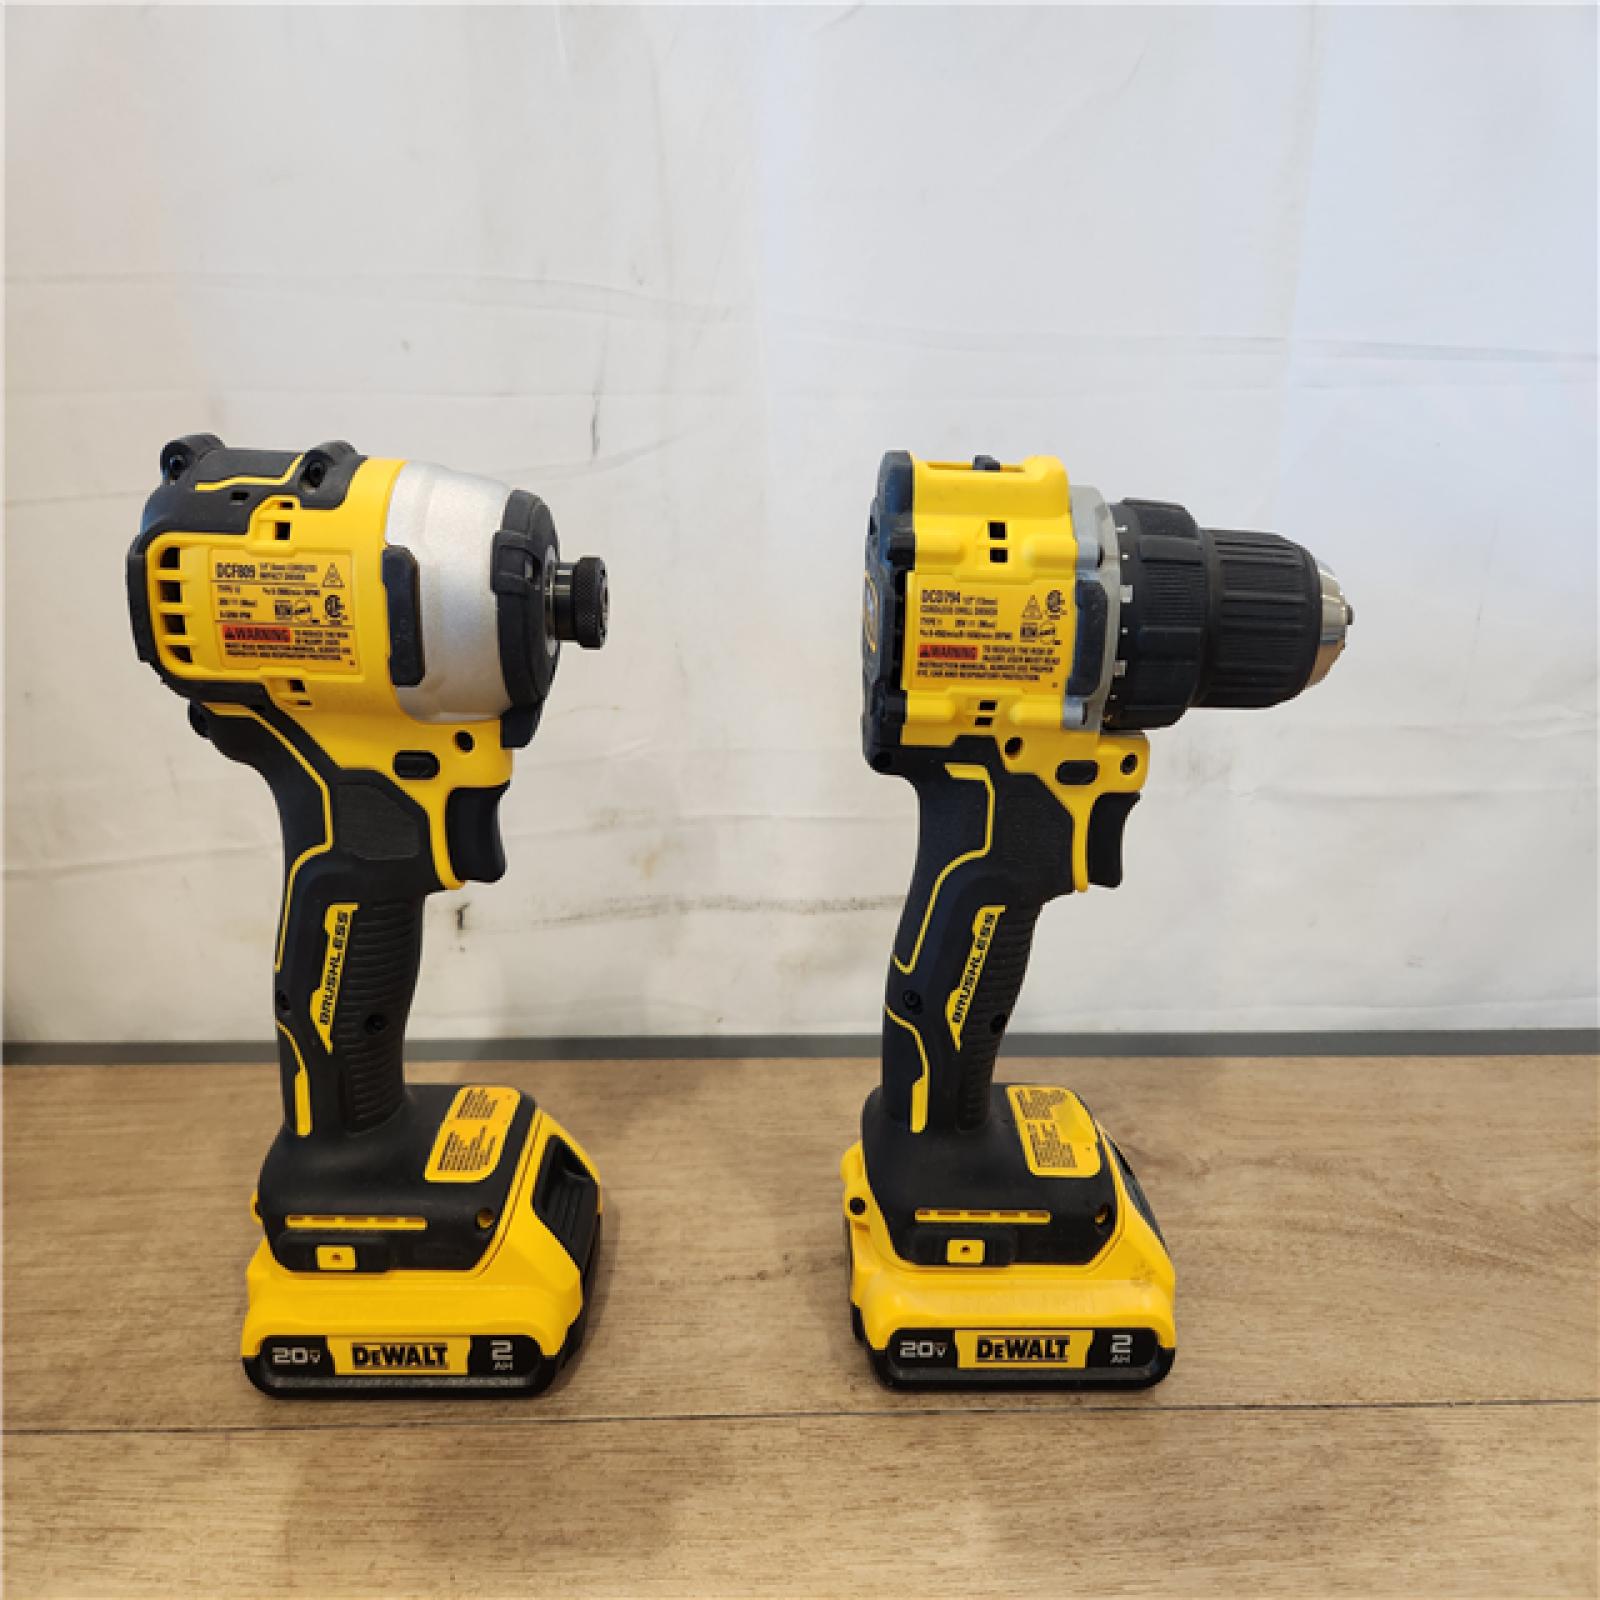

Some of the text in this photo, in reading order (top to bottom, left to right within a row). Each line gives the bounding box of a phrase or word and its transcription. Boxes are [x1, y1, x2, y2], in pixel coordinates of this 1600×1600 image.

[216, 562, 256, 578] DCF809
[921, 589, 961, 604] DCD794
[236, 628, 290, 642] WARNING
[930, 645, 978, 661] WARNING
[319, 911, 349, 1026] BRUSHLESS
[952, 911, 996, 1023] BRUSHLESS
[490, 1340, 514, 1361] 2
[1110, 1334, 1134, 1355] 2
